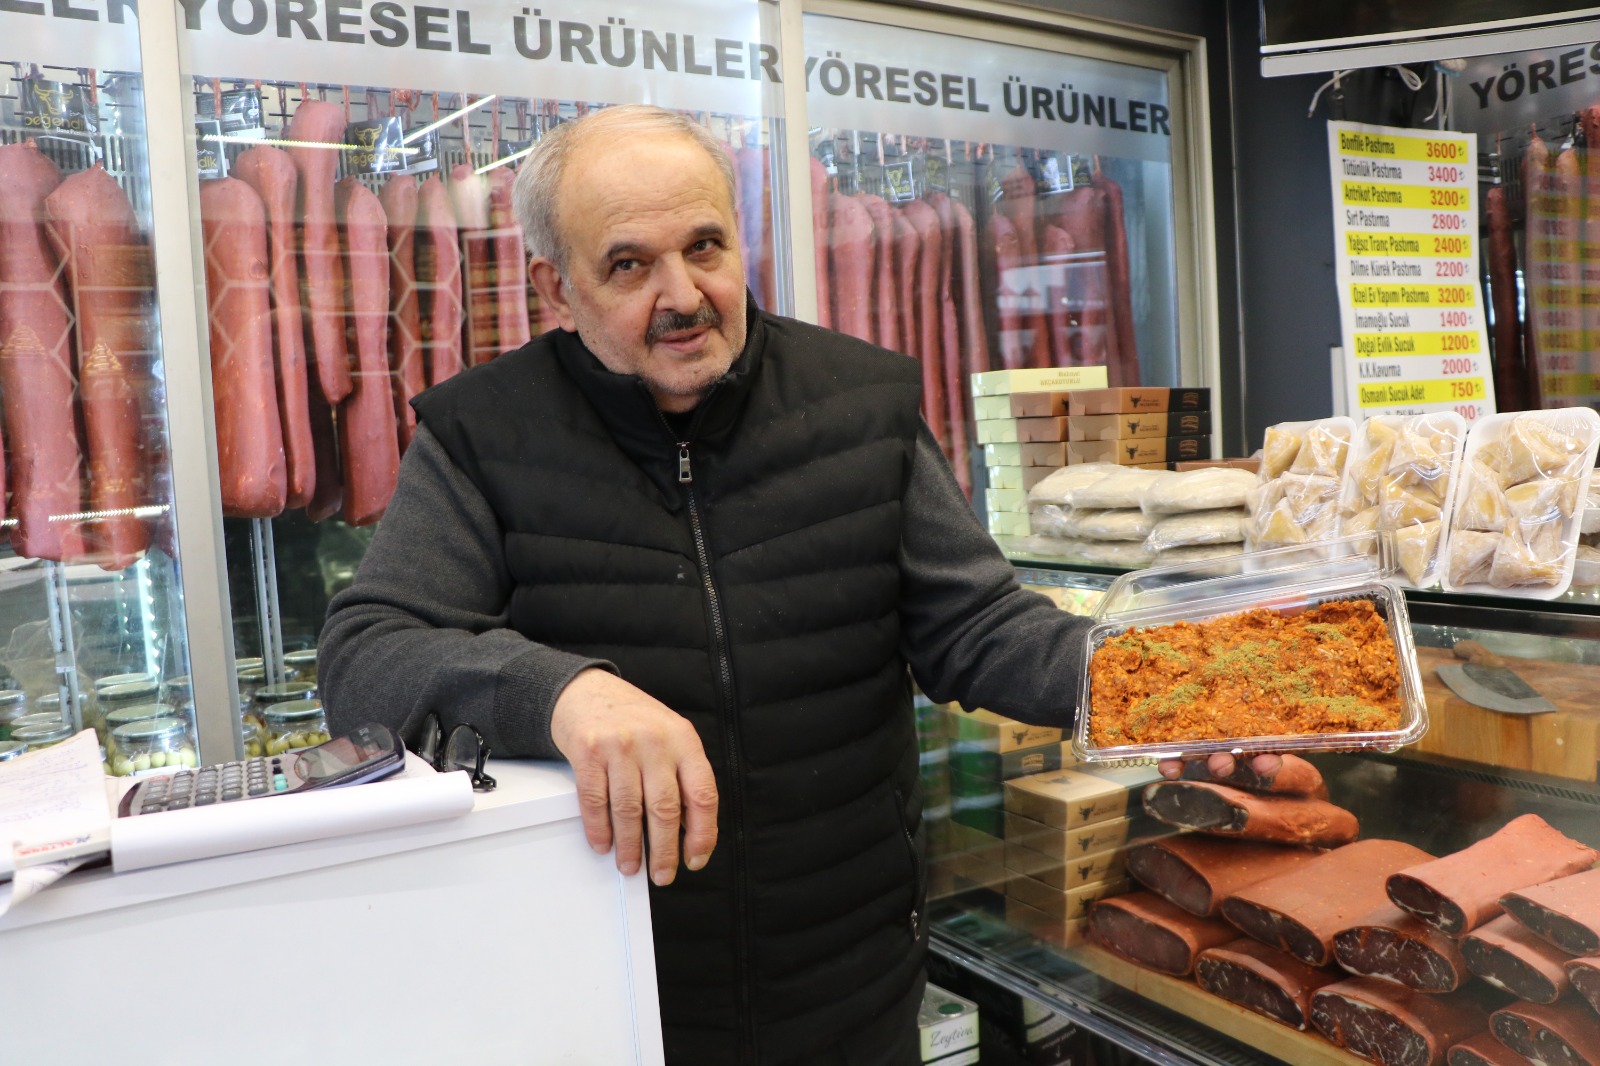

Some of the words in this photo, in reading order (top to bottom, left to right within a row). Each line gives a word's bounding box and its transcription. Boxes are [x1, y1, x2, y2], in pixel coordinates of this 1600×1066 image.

[513, 7, 783, 84] ÜRÜNLER
[1002, 76, 1171, 136] ÜRÜNLER
[1341, 133, 1364, 150] Bonfile
[1365, 136, 1395, 154] Pastırma
[1342, 159, 1371, 177] Tütünlük
[1372, 162, 1402, 179] Pastırma
[1345, 184, 1370, 202] Antrikot
[1372, 187, 1402, 203] Pastırma
[1346, 210, 1359, 226] Sırt
[1360, 212, 1390, 227] Pastırma
[1348, 235, 1369, 255] Yağsız
[1369, 236, 1389, 256] Tranç
[1390, 237, 1419, 252] Pastırma
[1351, 260, 1369, 276] Dilme
[1371, 260, 1391, 276] Kürek
[1392, 261, 1422, 277] Pastırma
[1353, 283, 1367, 302] Özel
[1368, 287, 1376, 303] Ev
[1377, 287, 1400, 306] Yapımı
[1401, 287, 1429, 303] Pastırma
[1354, 308, 1389, 331] İmamoğlu
[1389, 312, 1410, 328] Sucuk
[1357, 337, 1376, 357] Doğal
[1377, 337, 1394, 353] Evlik
[1394, 336, 1415, 352] Sucuk
[1359, 362, 1401, 378] K.K.Kavurma
[1361, 387, 1388, 403] Osmanlı
[1389, 385, 1410, 402] Sucuk
[1411, 385, 1425, 400] Adet
